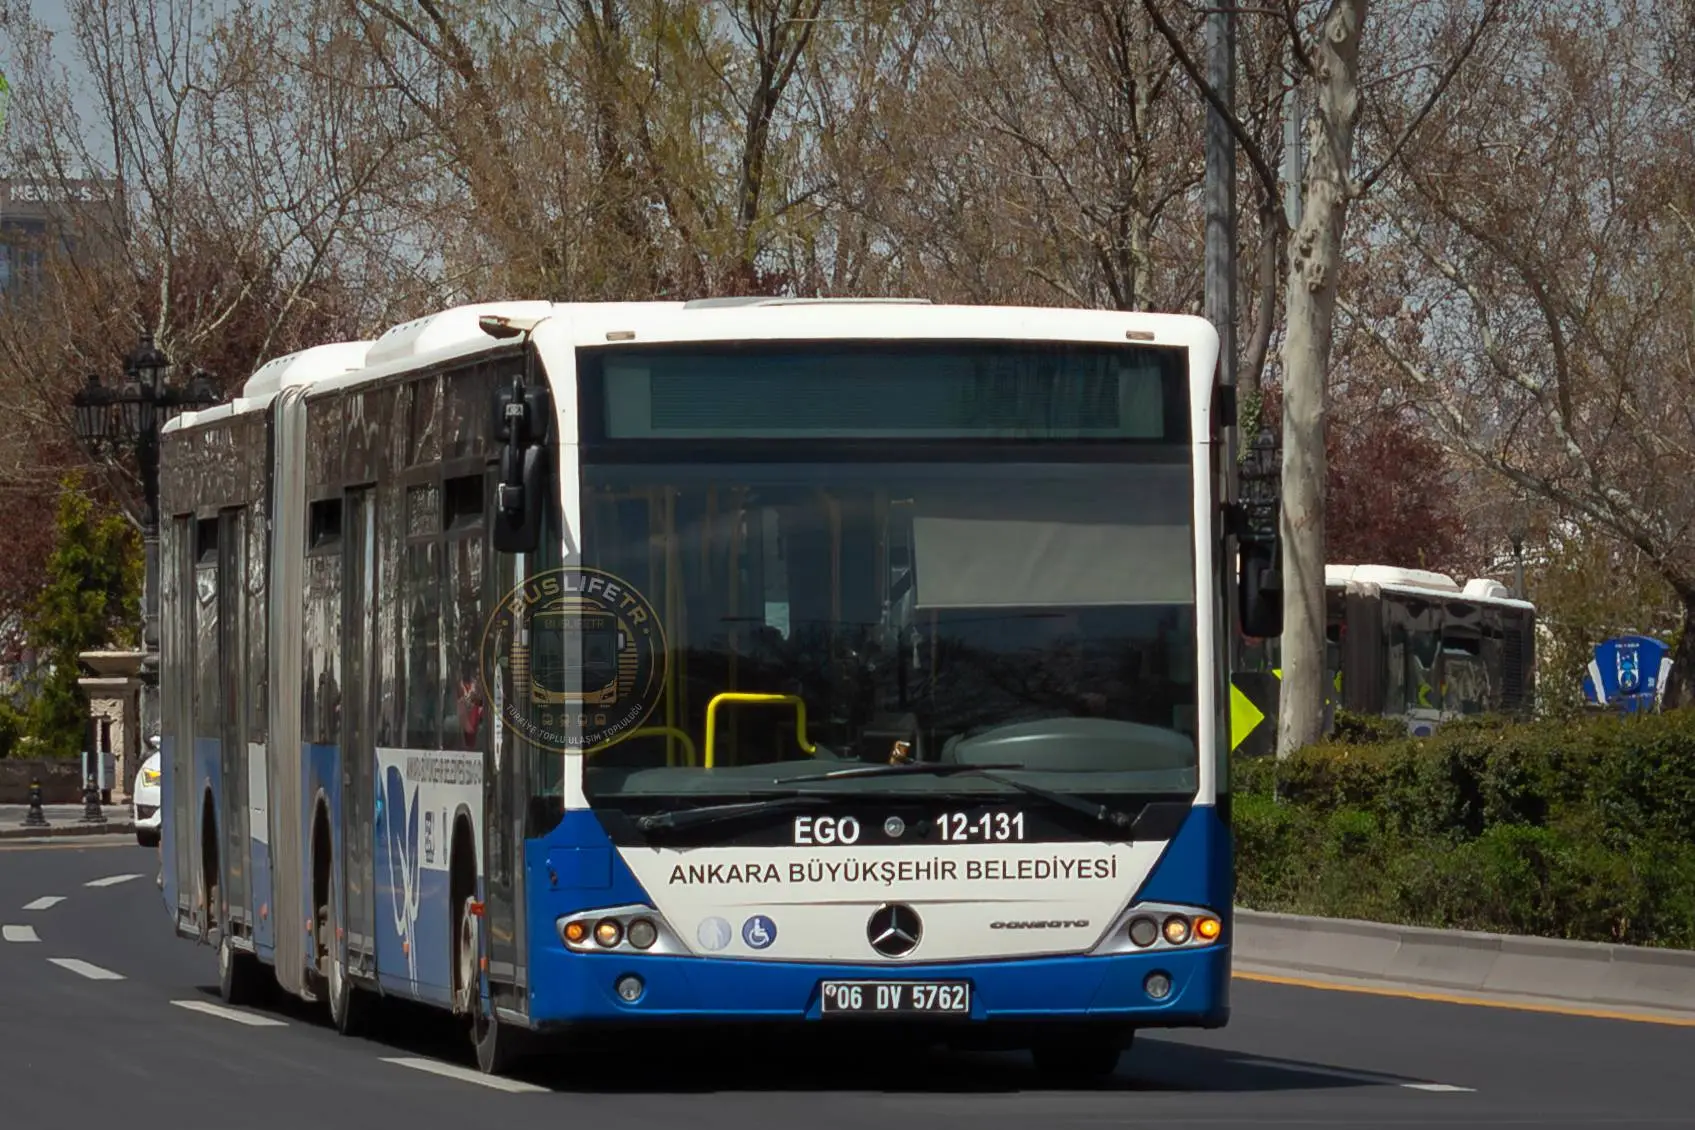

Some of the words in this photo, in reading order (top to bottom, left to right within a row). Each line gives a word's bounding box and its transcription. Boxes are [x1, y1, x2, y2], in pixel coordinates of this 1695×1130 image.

[794, 816, 860, 844] EGO
[936, 812, 1024, 841] 12-131
[669, 863, 781, 885] ANKARA
[789, 857, 957, 887] BÜYÜKŞEHİR
[966, 854, 1116, 880] BELEDİYESİ
[837, 985, 862, 1010] 06
[876, 985, 902, 1010] DV
[912, 985, 964, 1010] 5762
